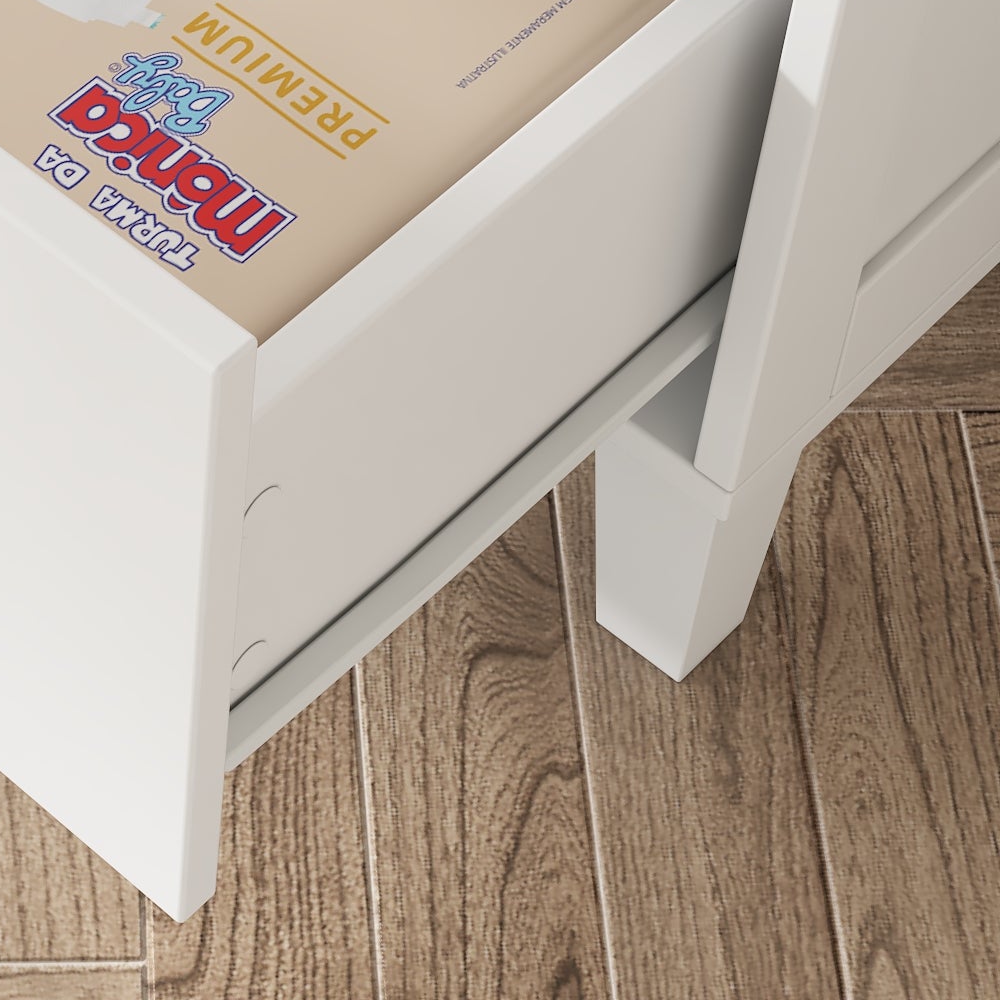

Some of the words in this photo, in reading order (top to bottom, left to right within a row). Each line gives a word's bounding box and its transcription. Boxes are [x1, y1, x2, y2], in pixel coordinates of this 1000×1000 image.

[505, 6, 558, 50] MERAMENTE
[112, 51, 234, 136] Baby
[182, 11, 377, 150] PREMIUM
[456, 47, 508, 89] ILUSTRATIVA
[33, 144, 90, 190] DA
[89, 185, 200, 271] TURMA
